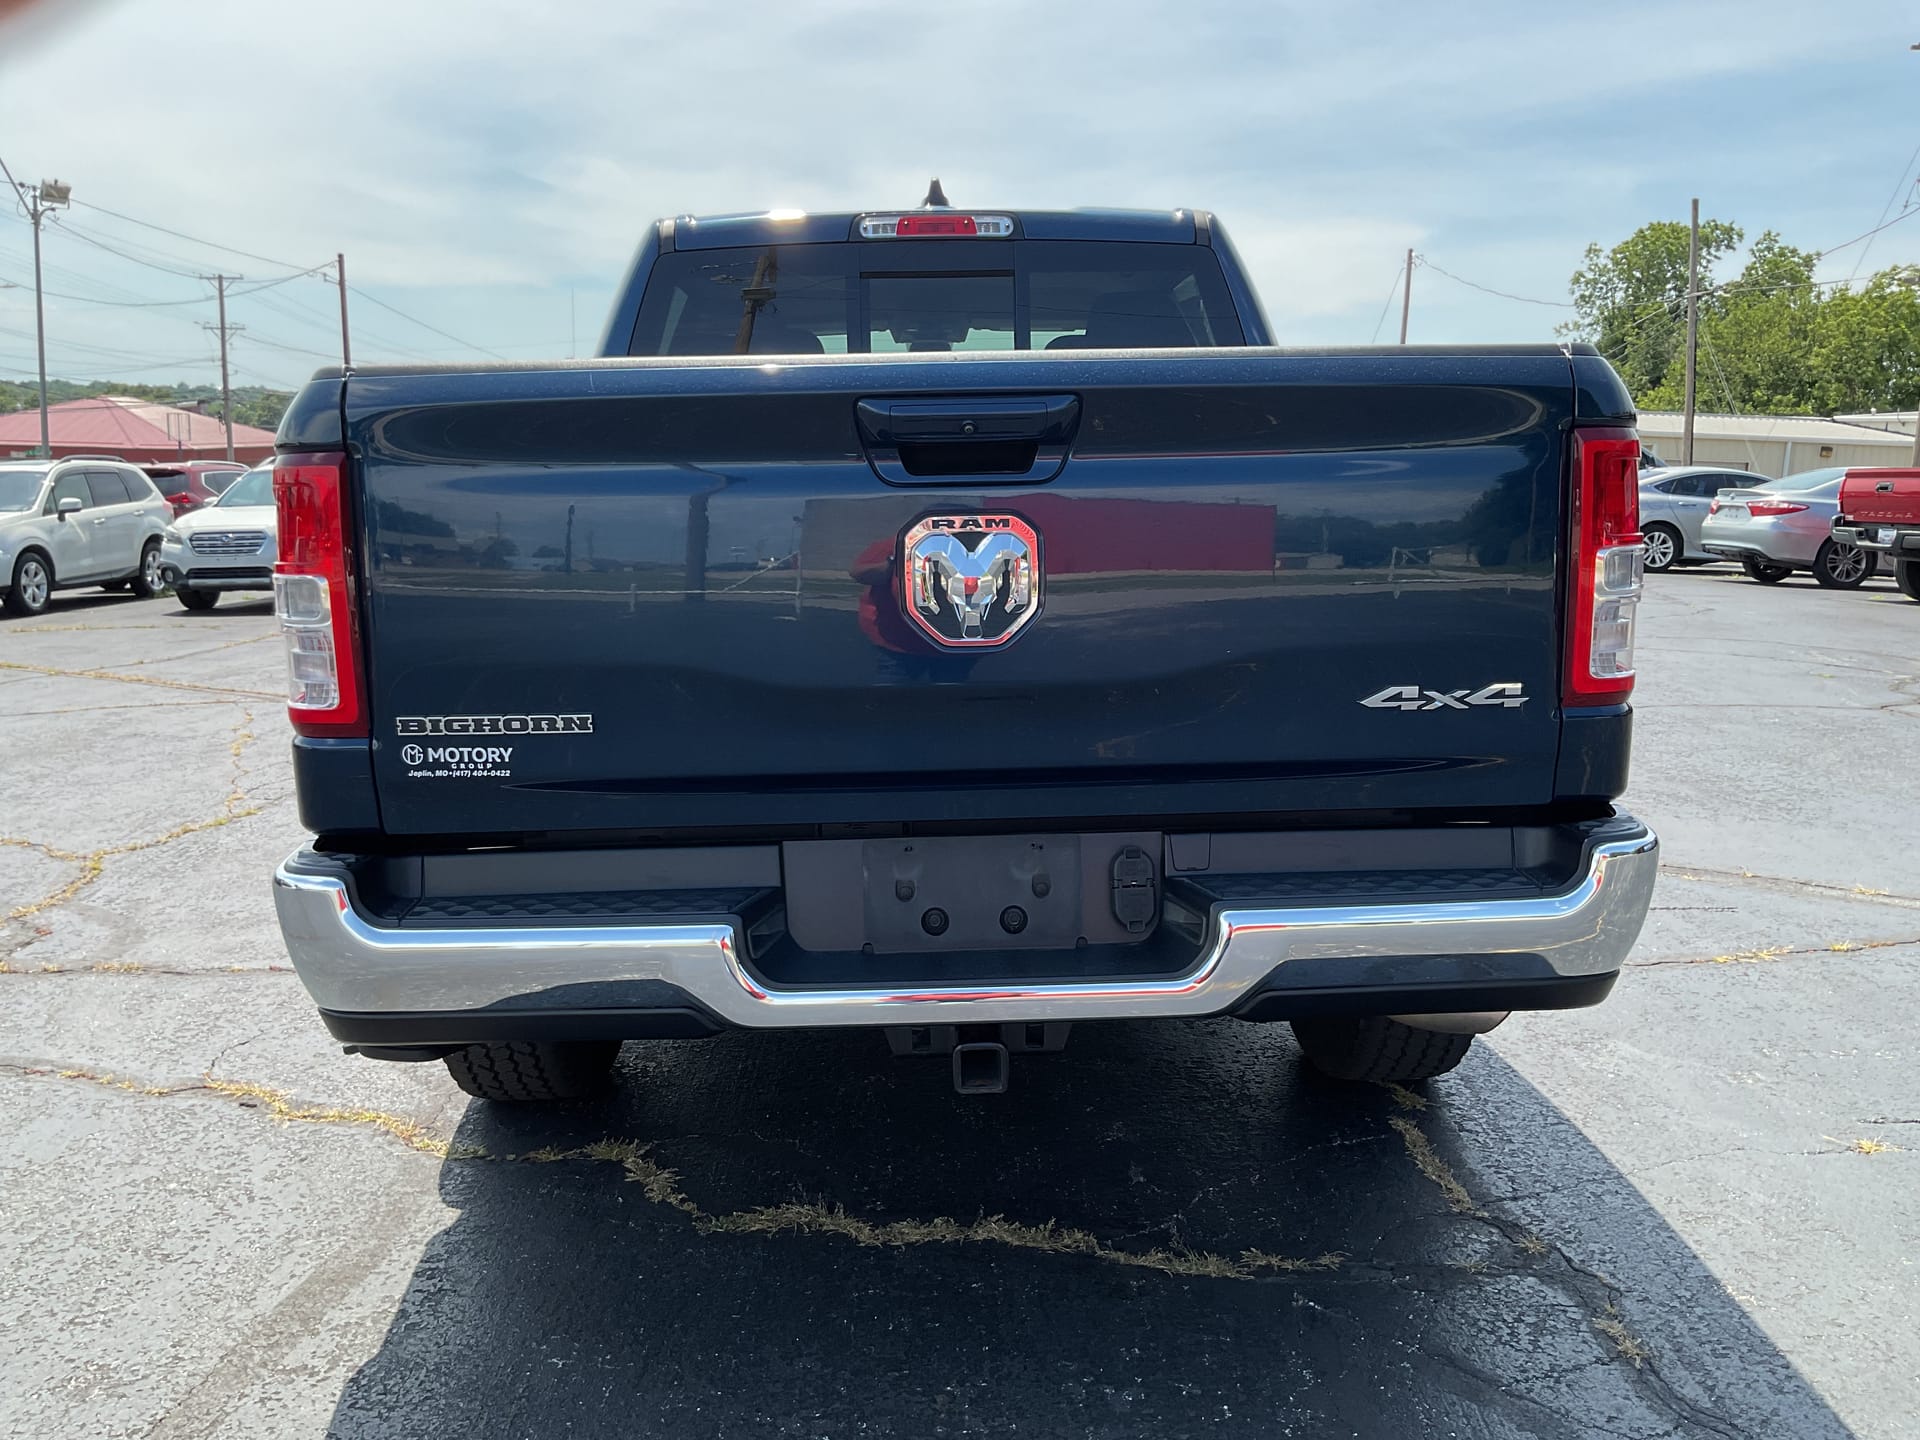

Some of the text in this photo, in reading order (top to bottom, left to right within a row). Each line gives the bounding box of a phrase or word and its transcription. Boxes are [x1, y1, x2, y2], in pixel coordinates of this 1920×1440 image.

[931, 518, 1010, 529] RAM
[1356, 682, 1530, 711] 4x4
[396, 714, 593, 736] BIGHORN
[427, 747, 513, 763] MOTORY
